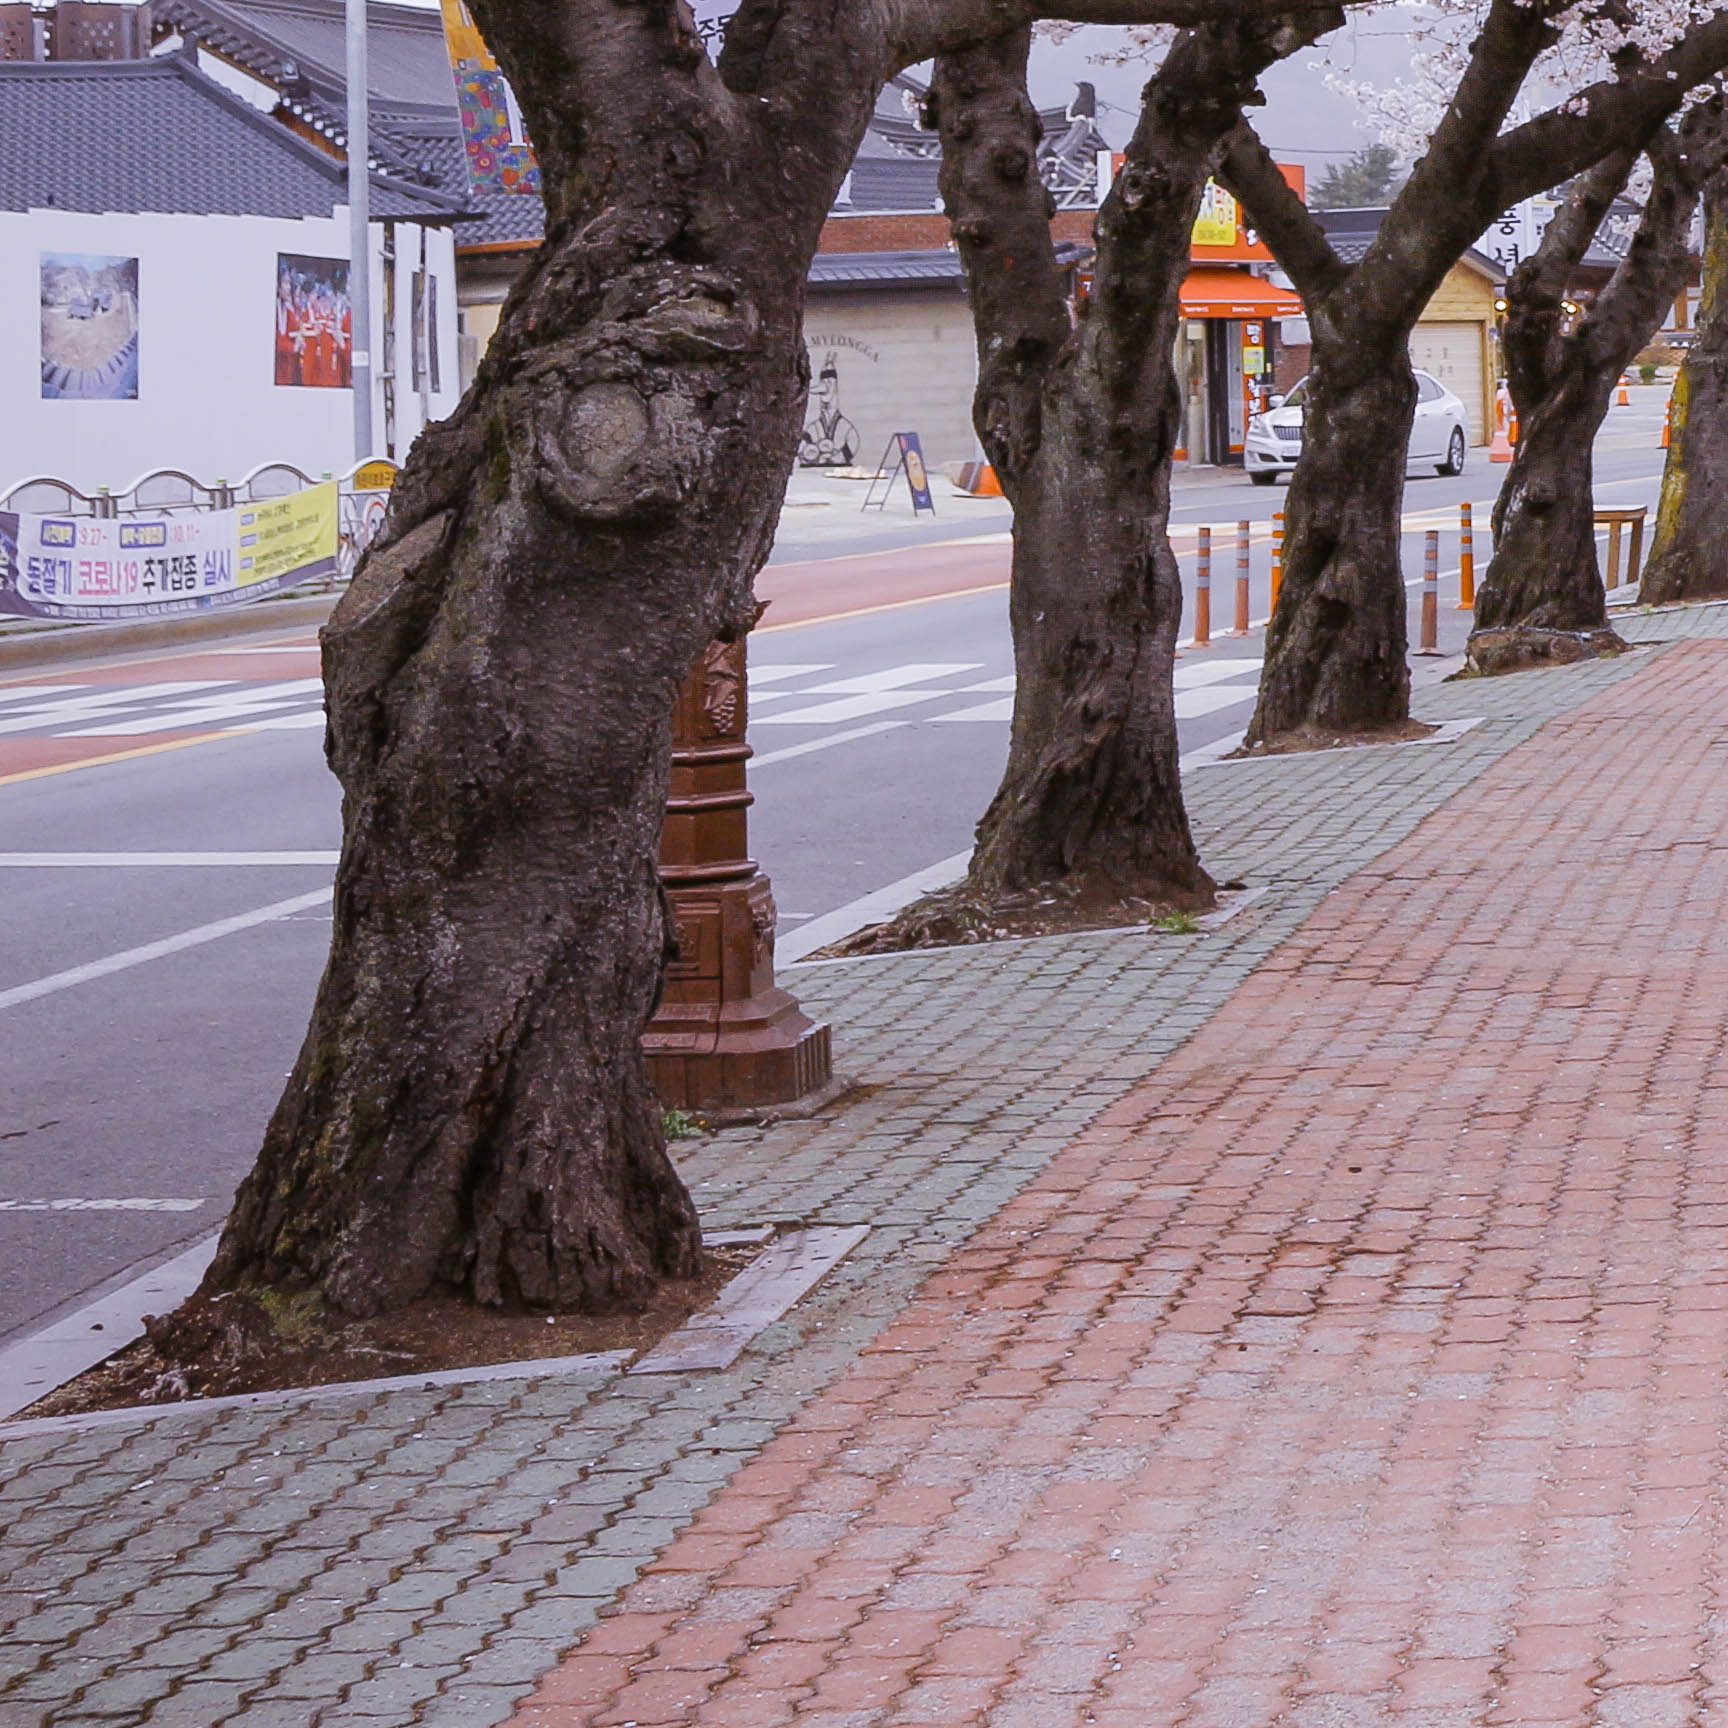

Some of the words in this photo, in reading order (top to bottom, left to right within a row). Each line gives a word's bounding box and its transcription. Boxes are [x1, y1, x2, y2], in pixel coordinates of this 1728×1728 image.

[27, 556, 72, 596] 동절기
[142, 554, 197, 595] 추가접종
[203, 548, 232, 588] 실시
